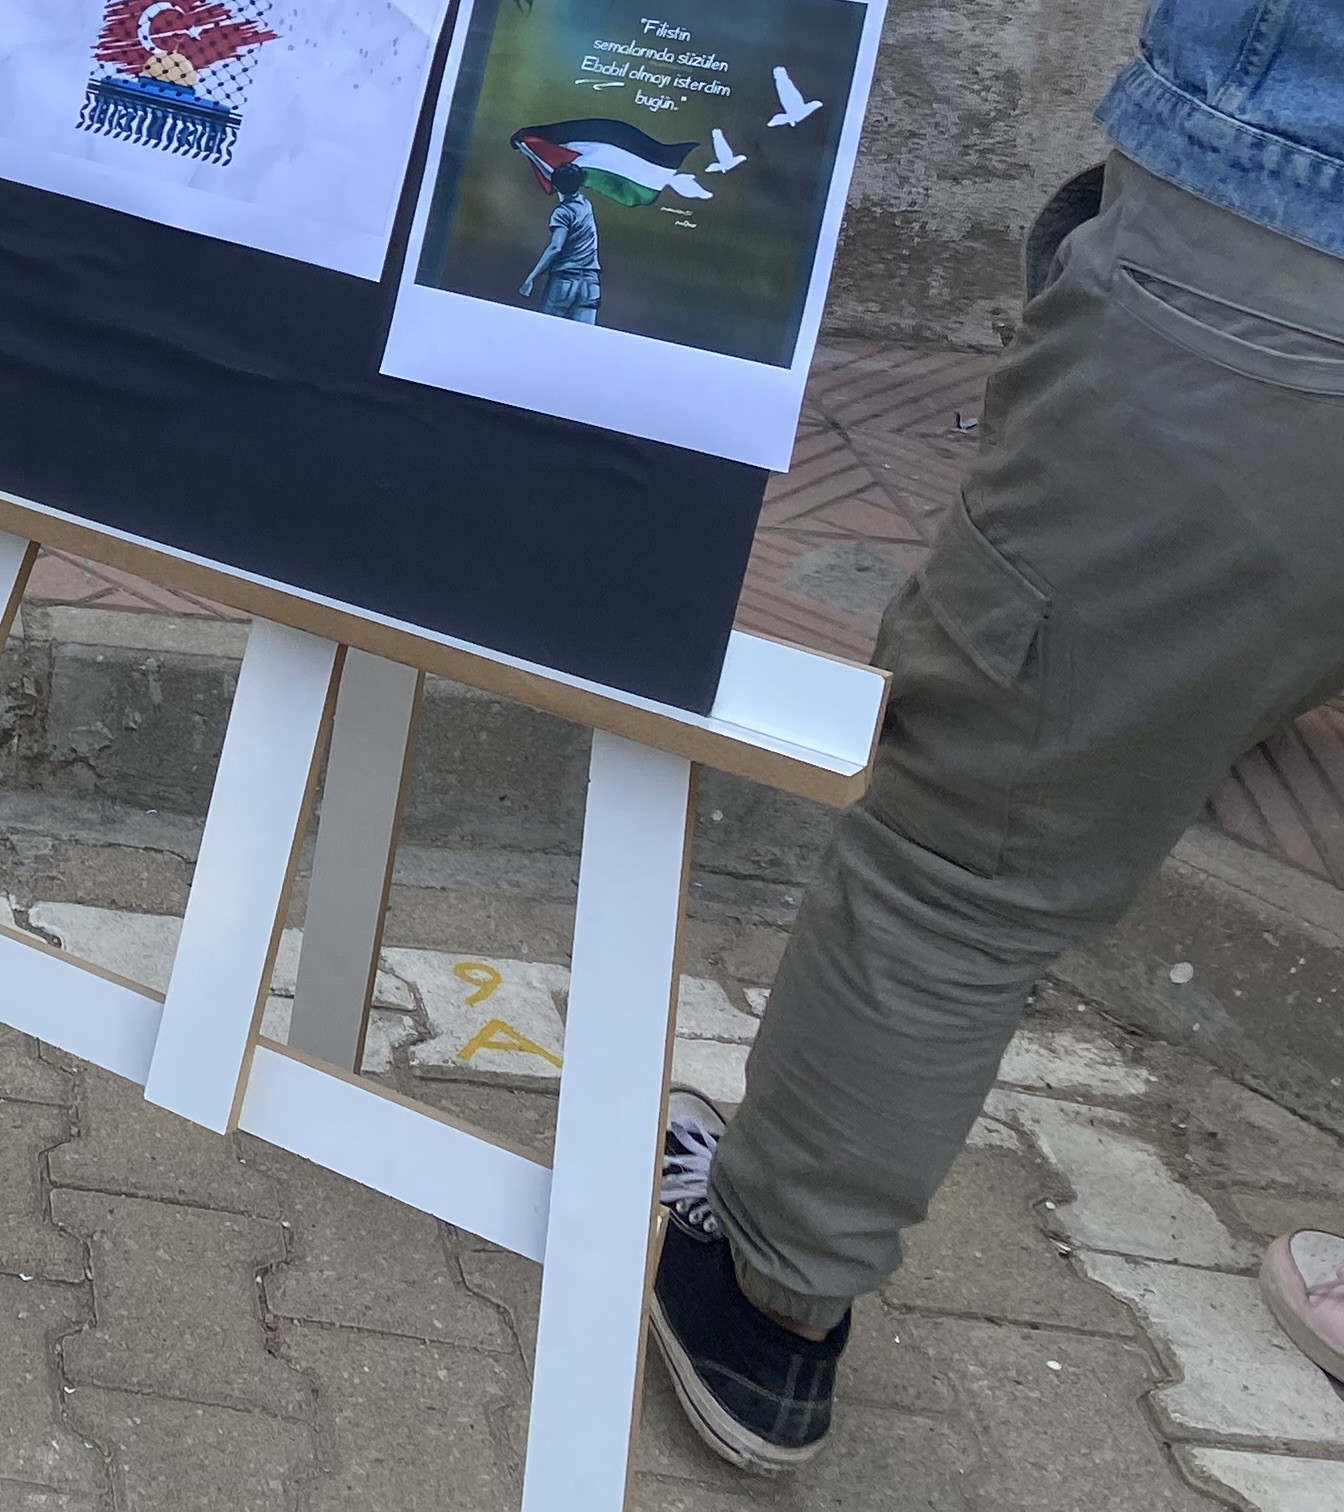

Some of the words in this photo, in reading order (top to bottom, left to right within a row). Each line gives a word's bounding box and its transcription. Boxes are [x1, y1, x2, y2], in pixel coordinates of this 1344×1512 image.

[580, 55, 630, 78] Ebabil
[628, 65, 673, 88] olmayı
[672, 73, 732, 97] isterdim
[592, 39, 675, 63] semalarında
[676, 51, 730, 73] süzülen
[453, 961, 503, 1007] 9
[455, 1018, 564, 1069] A
